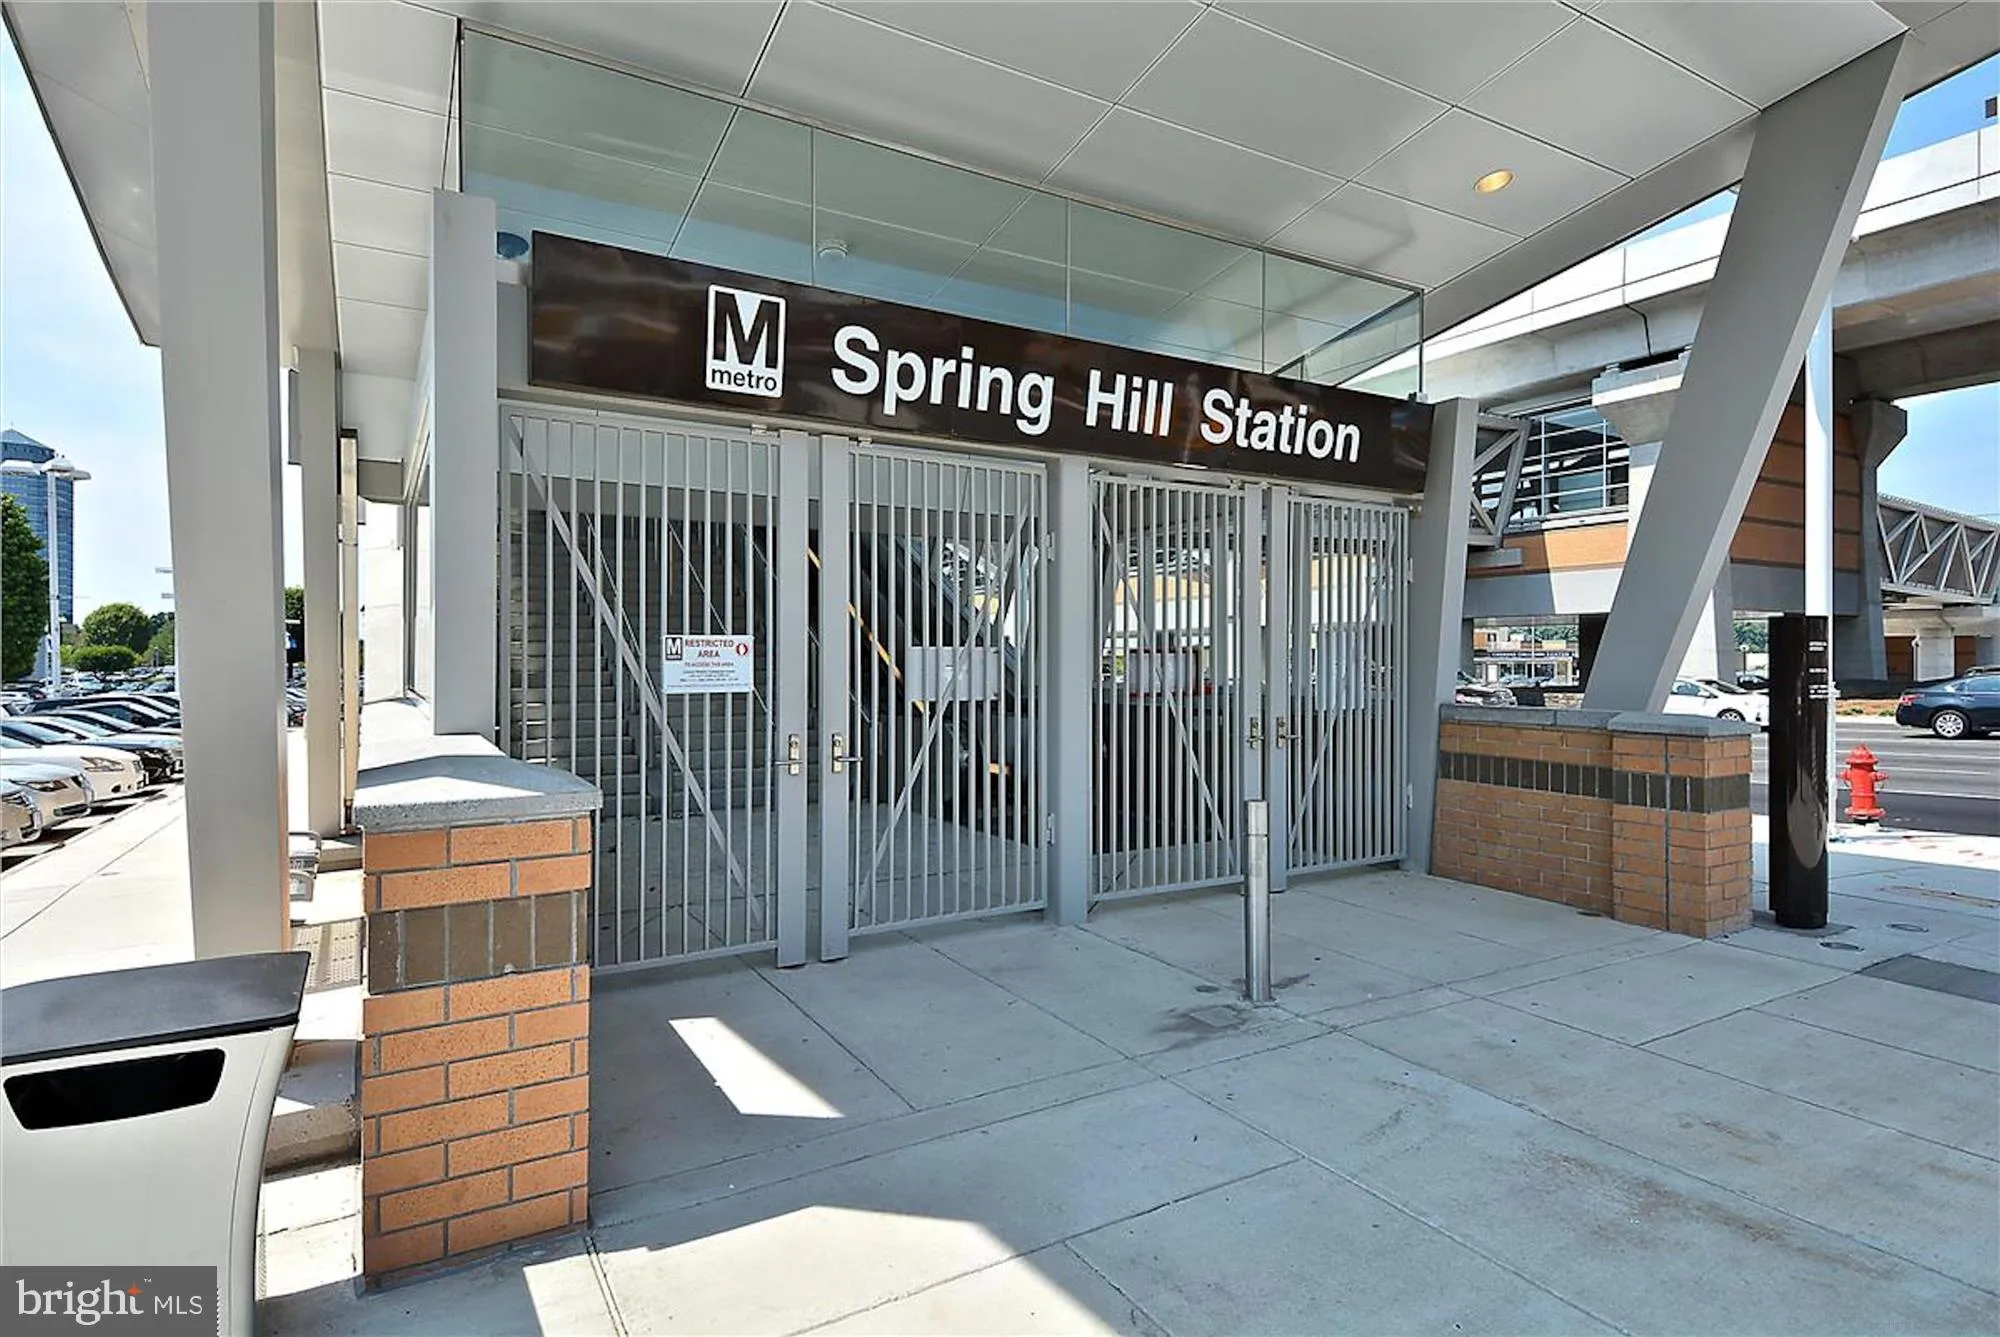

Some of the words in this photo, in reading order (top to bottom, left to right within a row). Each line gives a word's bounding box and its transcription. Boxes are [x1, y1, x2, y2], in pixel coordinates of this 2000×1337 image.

[712, 291, 781, 369] M
[711, 366, 777, 391] metro
[831, 325, 1055, 436] Spring
[1085, 369, 1174, 437] Hill
[1201, 388, 1361, 463] Station
[685, 640, 734, 648] RESTRICTED
[698, 650, 720, 658] AREA
